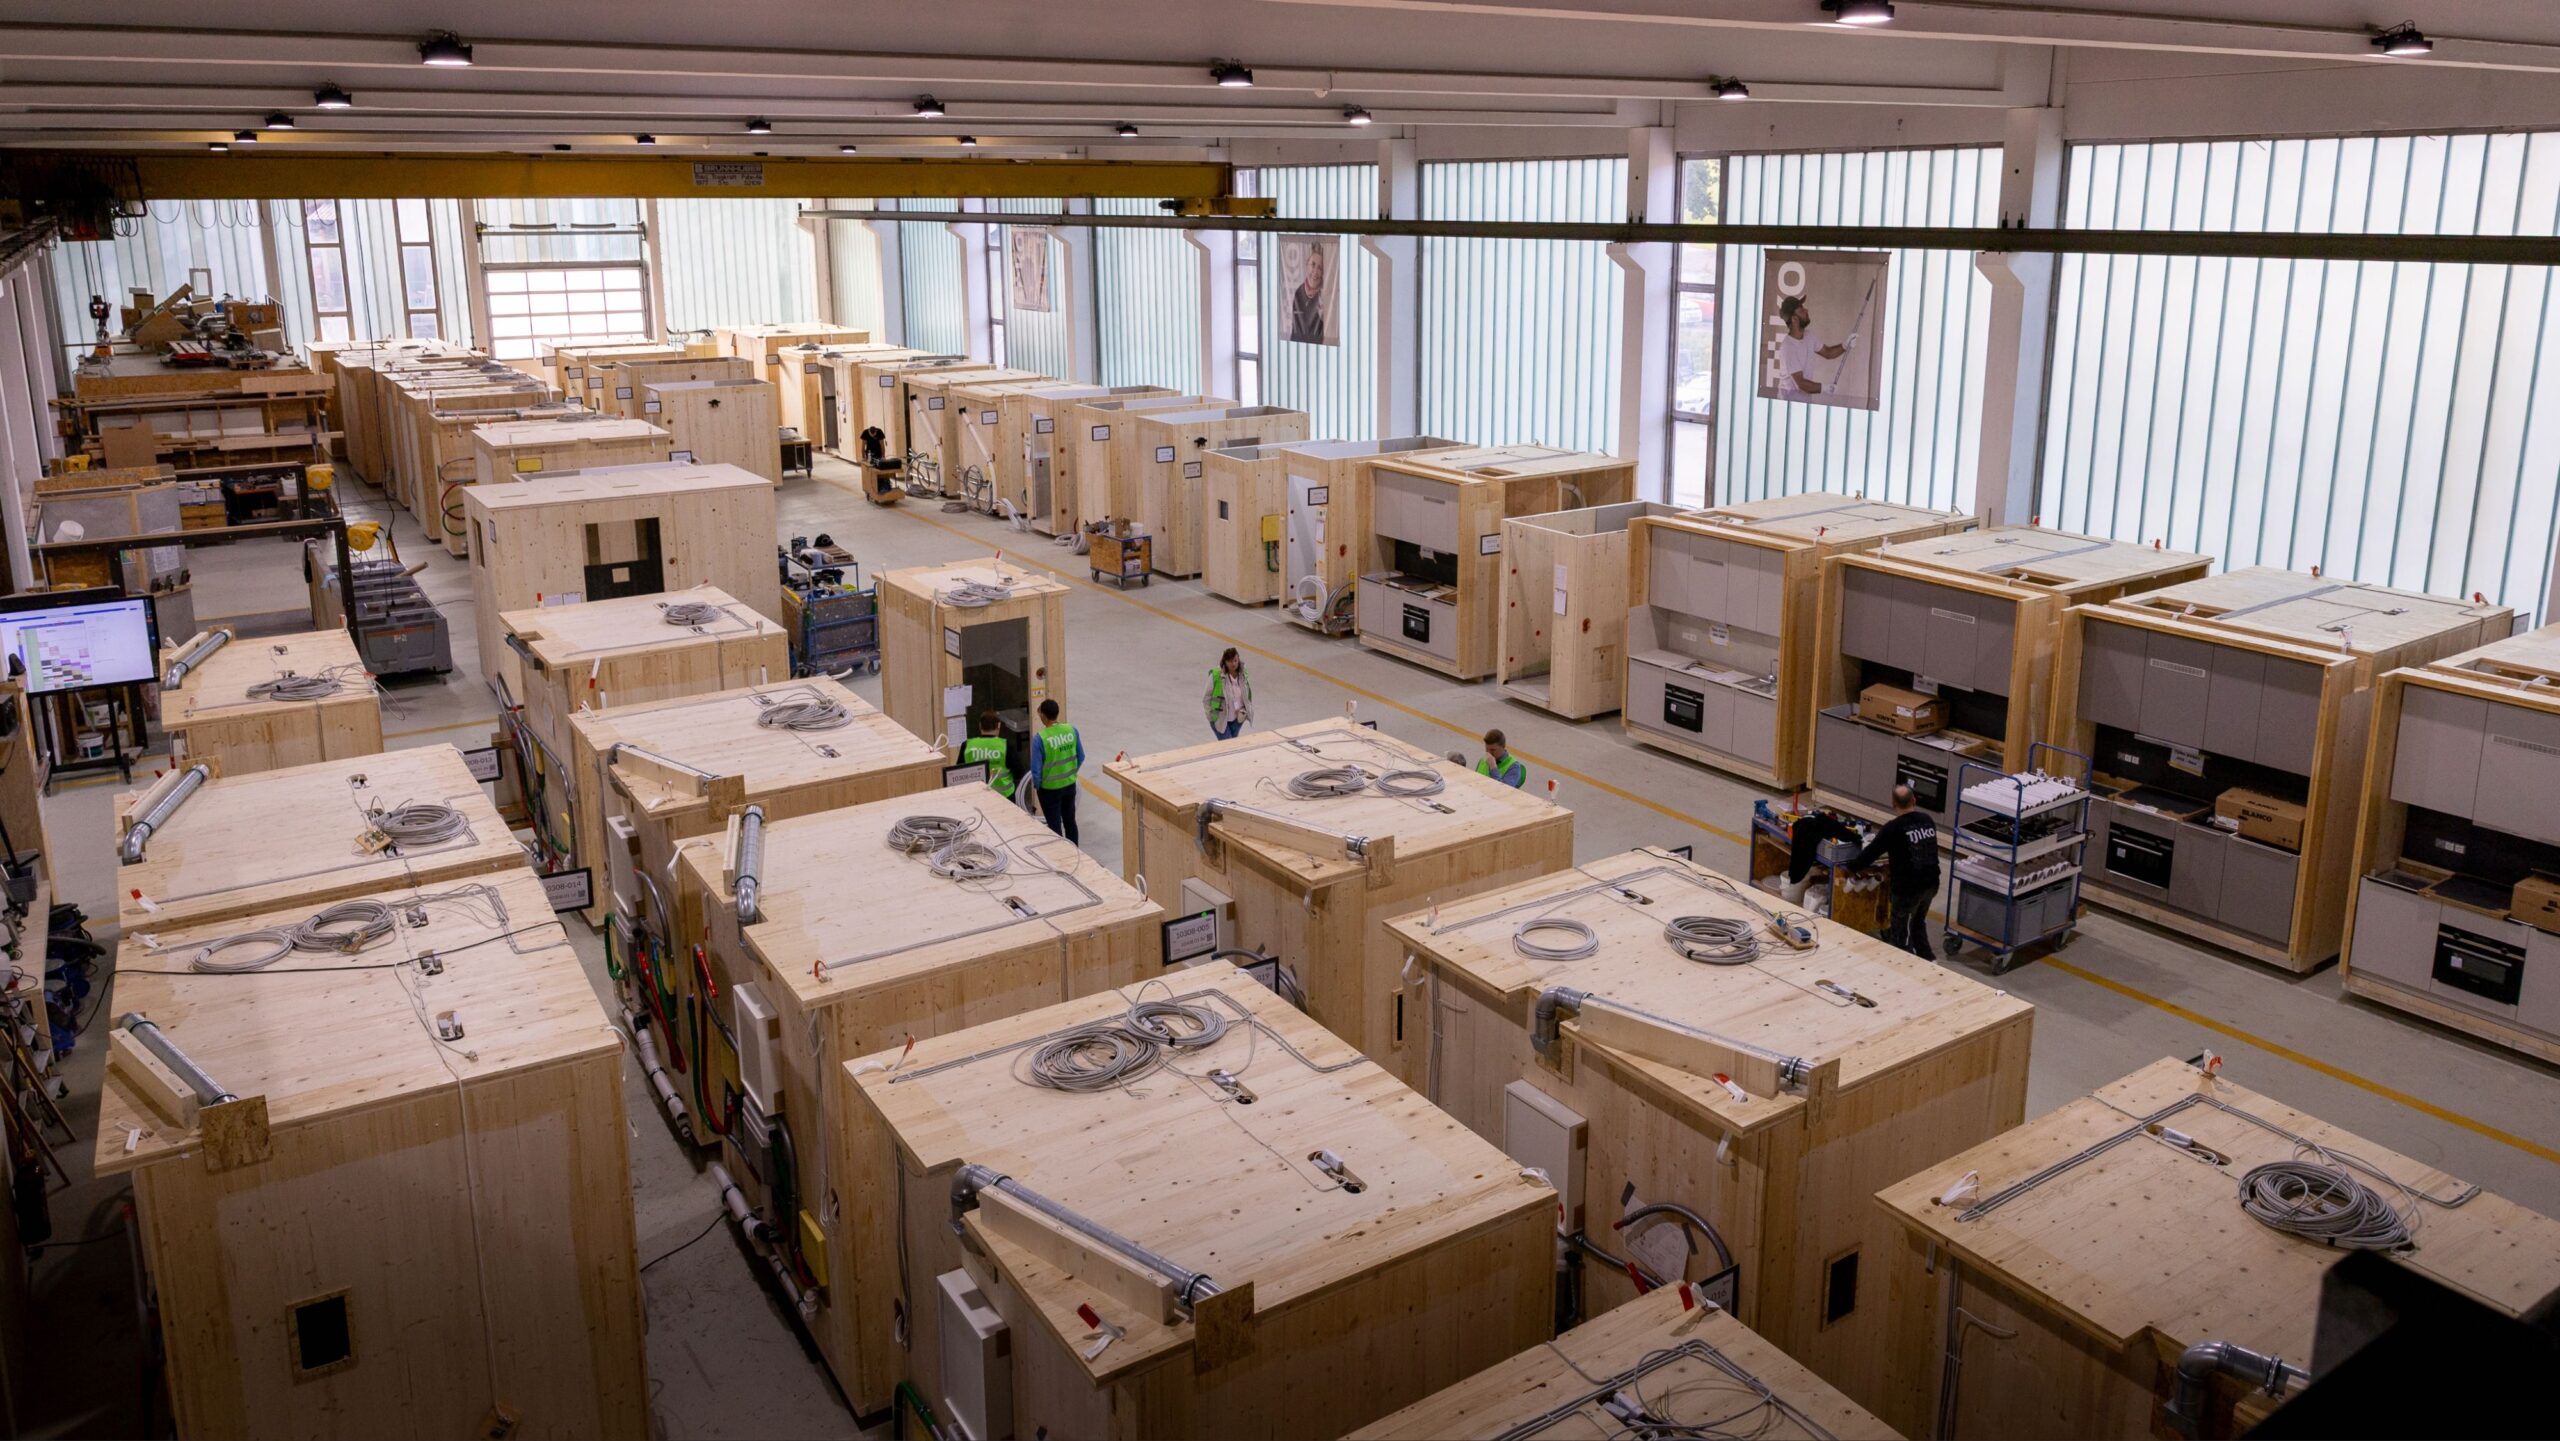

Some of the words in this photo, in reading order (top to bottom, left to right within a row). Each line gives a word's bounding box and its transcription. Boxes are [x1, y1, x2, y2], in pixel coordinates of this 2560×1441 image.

[1046, 732, 1075, 749] Tjiko
[970, 747, 1001, 760] Tjiko
[2242, 808, 2273, 822] BLANCO
[1905, 828, 1936, 844] Tjiko
